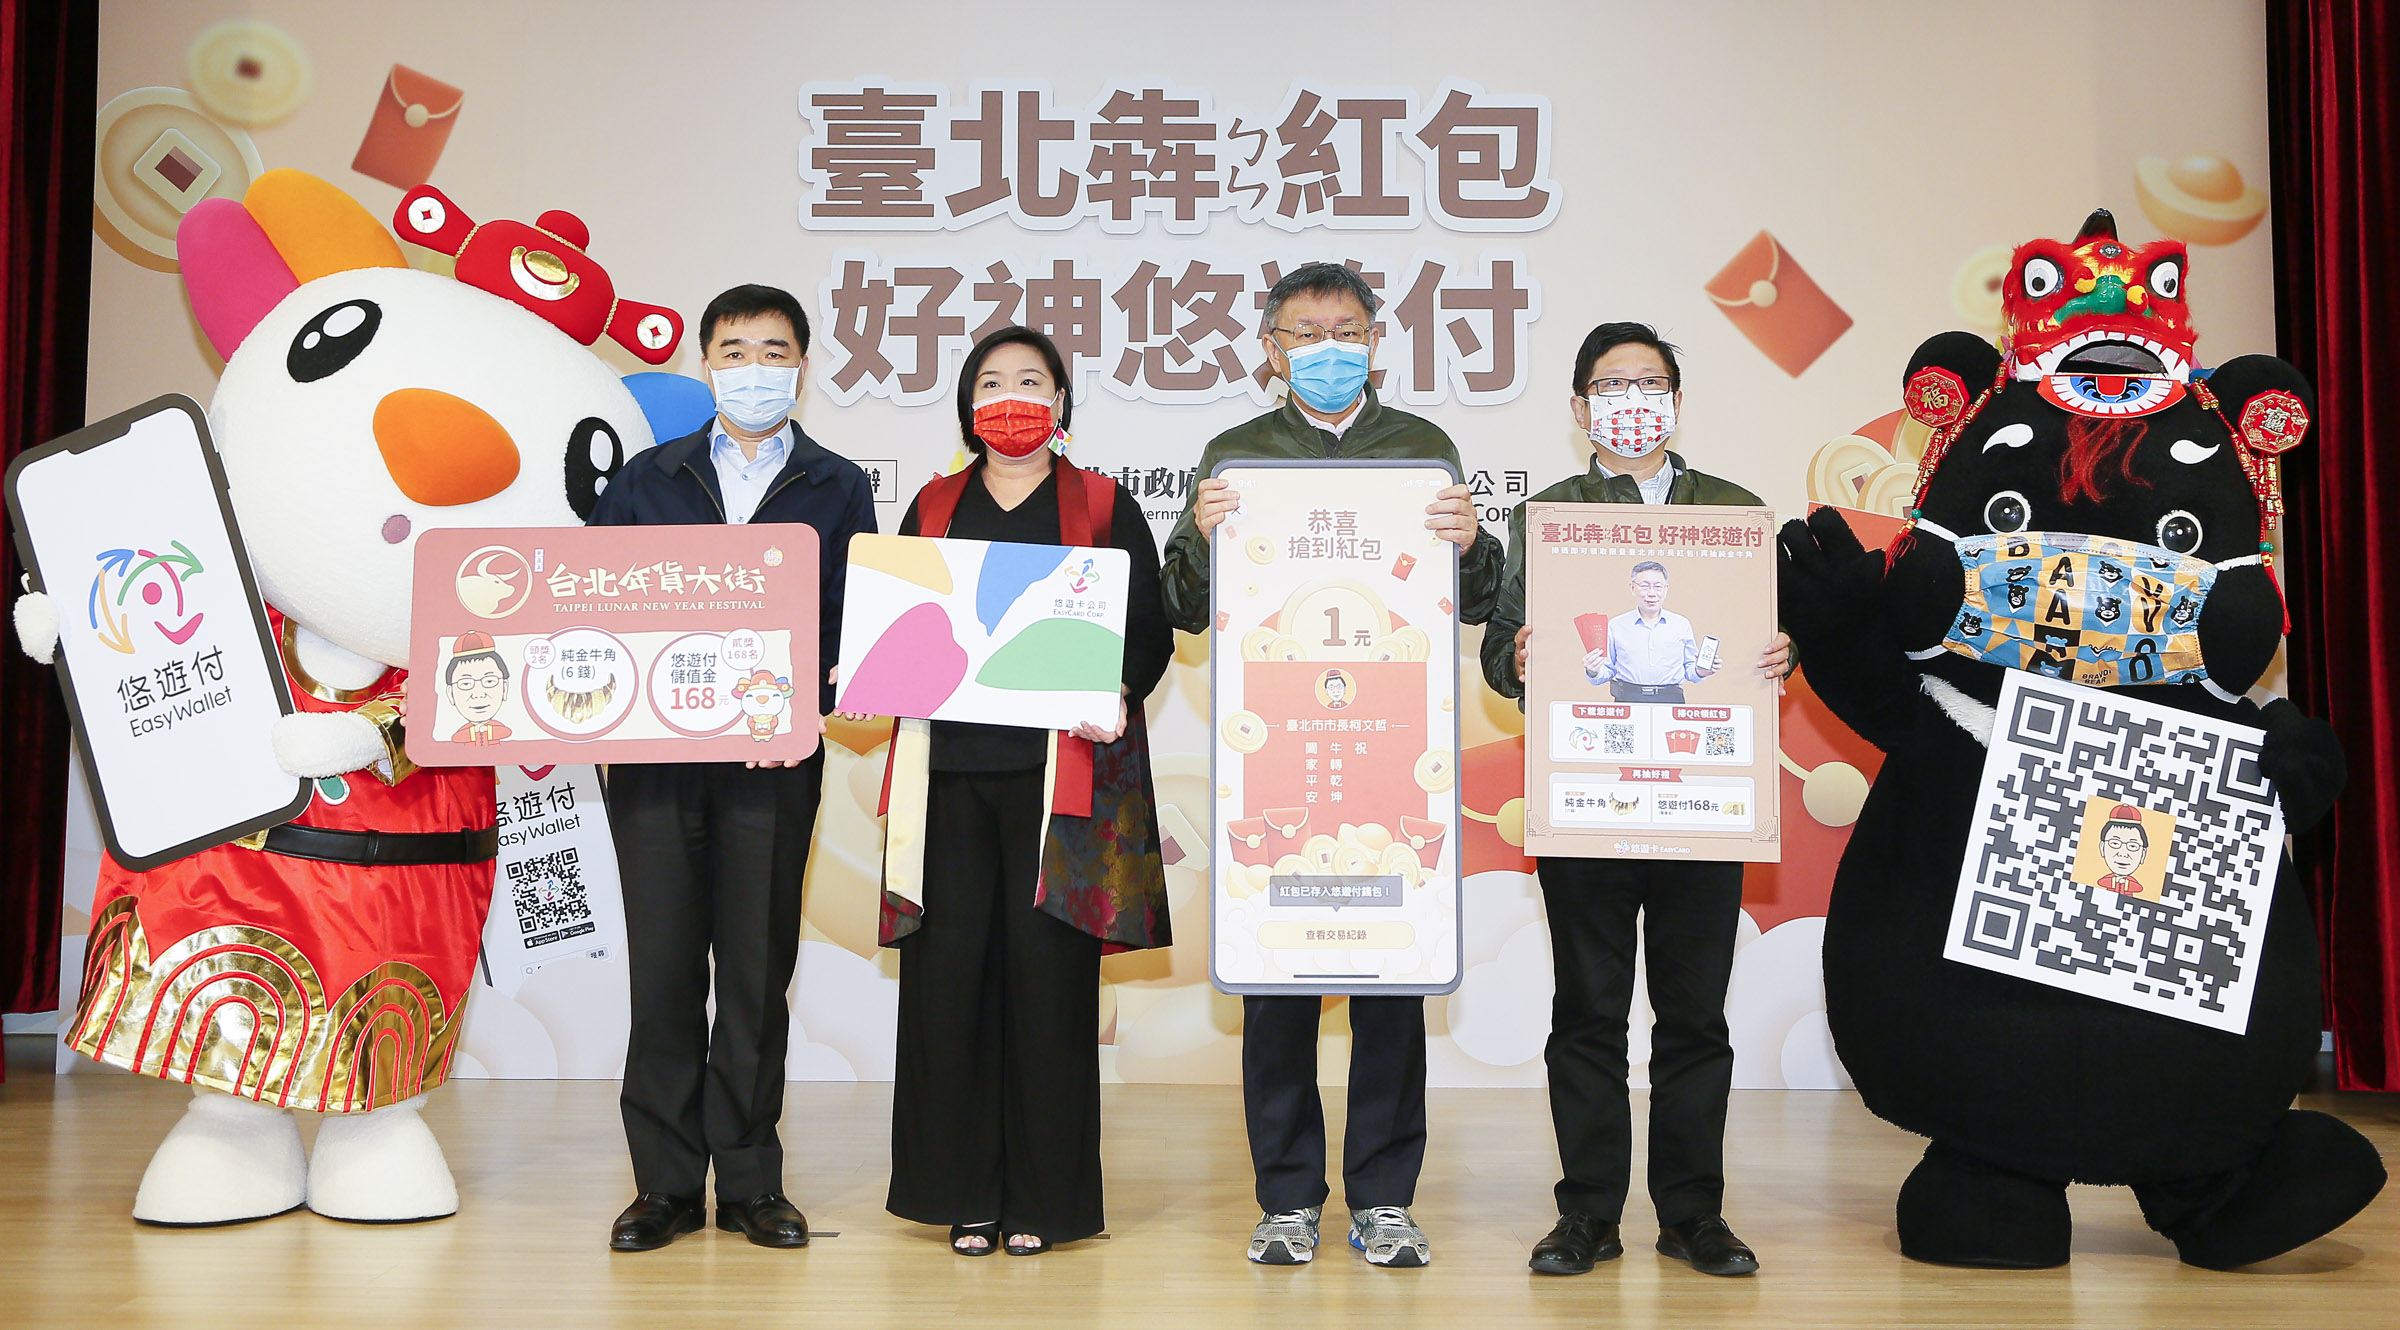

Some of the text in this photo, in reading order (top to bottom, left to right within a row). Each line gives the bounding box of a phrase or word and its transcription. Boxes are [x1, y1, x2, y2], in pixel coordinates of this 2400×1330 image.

[831, 260, 1529, 392] 好神悠付
[1468, 471, 1528, 497] 公司
[1307, 509, 1358, 537] 恭喜
[1658, 525, 1764, 547] 好神悠遊付
[1287, 537, 1382, 561] 搶到紅包
[546, 561, 766, 598] 台北年貨大街
[553, 600, 766, 612] TAIPEI LUNAR NEW YEAR FESTIVAL
[1054, 599, 1106, 610] 悠遊卡公司
[529, 646, 550, 654] 頭獎
[561, 648, 616, 662] 純金牛角
[727, 649, 758, 660] 168名
[531, 655, 547, 664] 2名
[671, 652, 717, 668] 悠遊付
[117, 645, 223, 713] 悠遊付
[670, 668, 717, 684] 儲值金
[130, 685, 232, 737] EasyWallet
[1577, 706, 1625, 717] 下載悠遊付
[1286, 719, 1387, 732] 臺北市市長柯文哲
[1354, 742, 1368, 755] 祝
[1330, 742, 1343, 803] 牛轉乾坤
[1564, 797, 1606, 808] 純金牛角
[1658, 799, 1719, 812] 悠遊付168元
[1306, 930, 1367, 941] 查看交易紀錄
